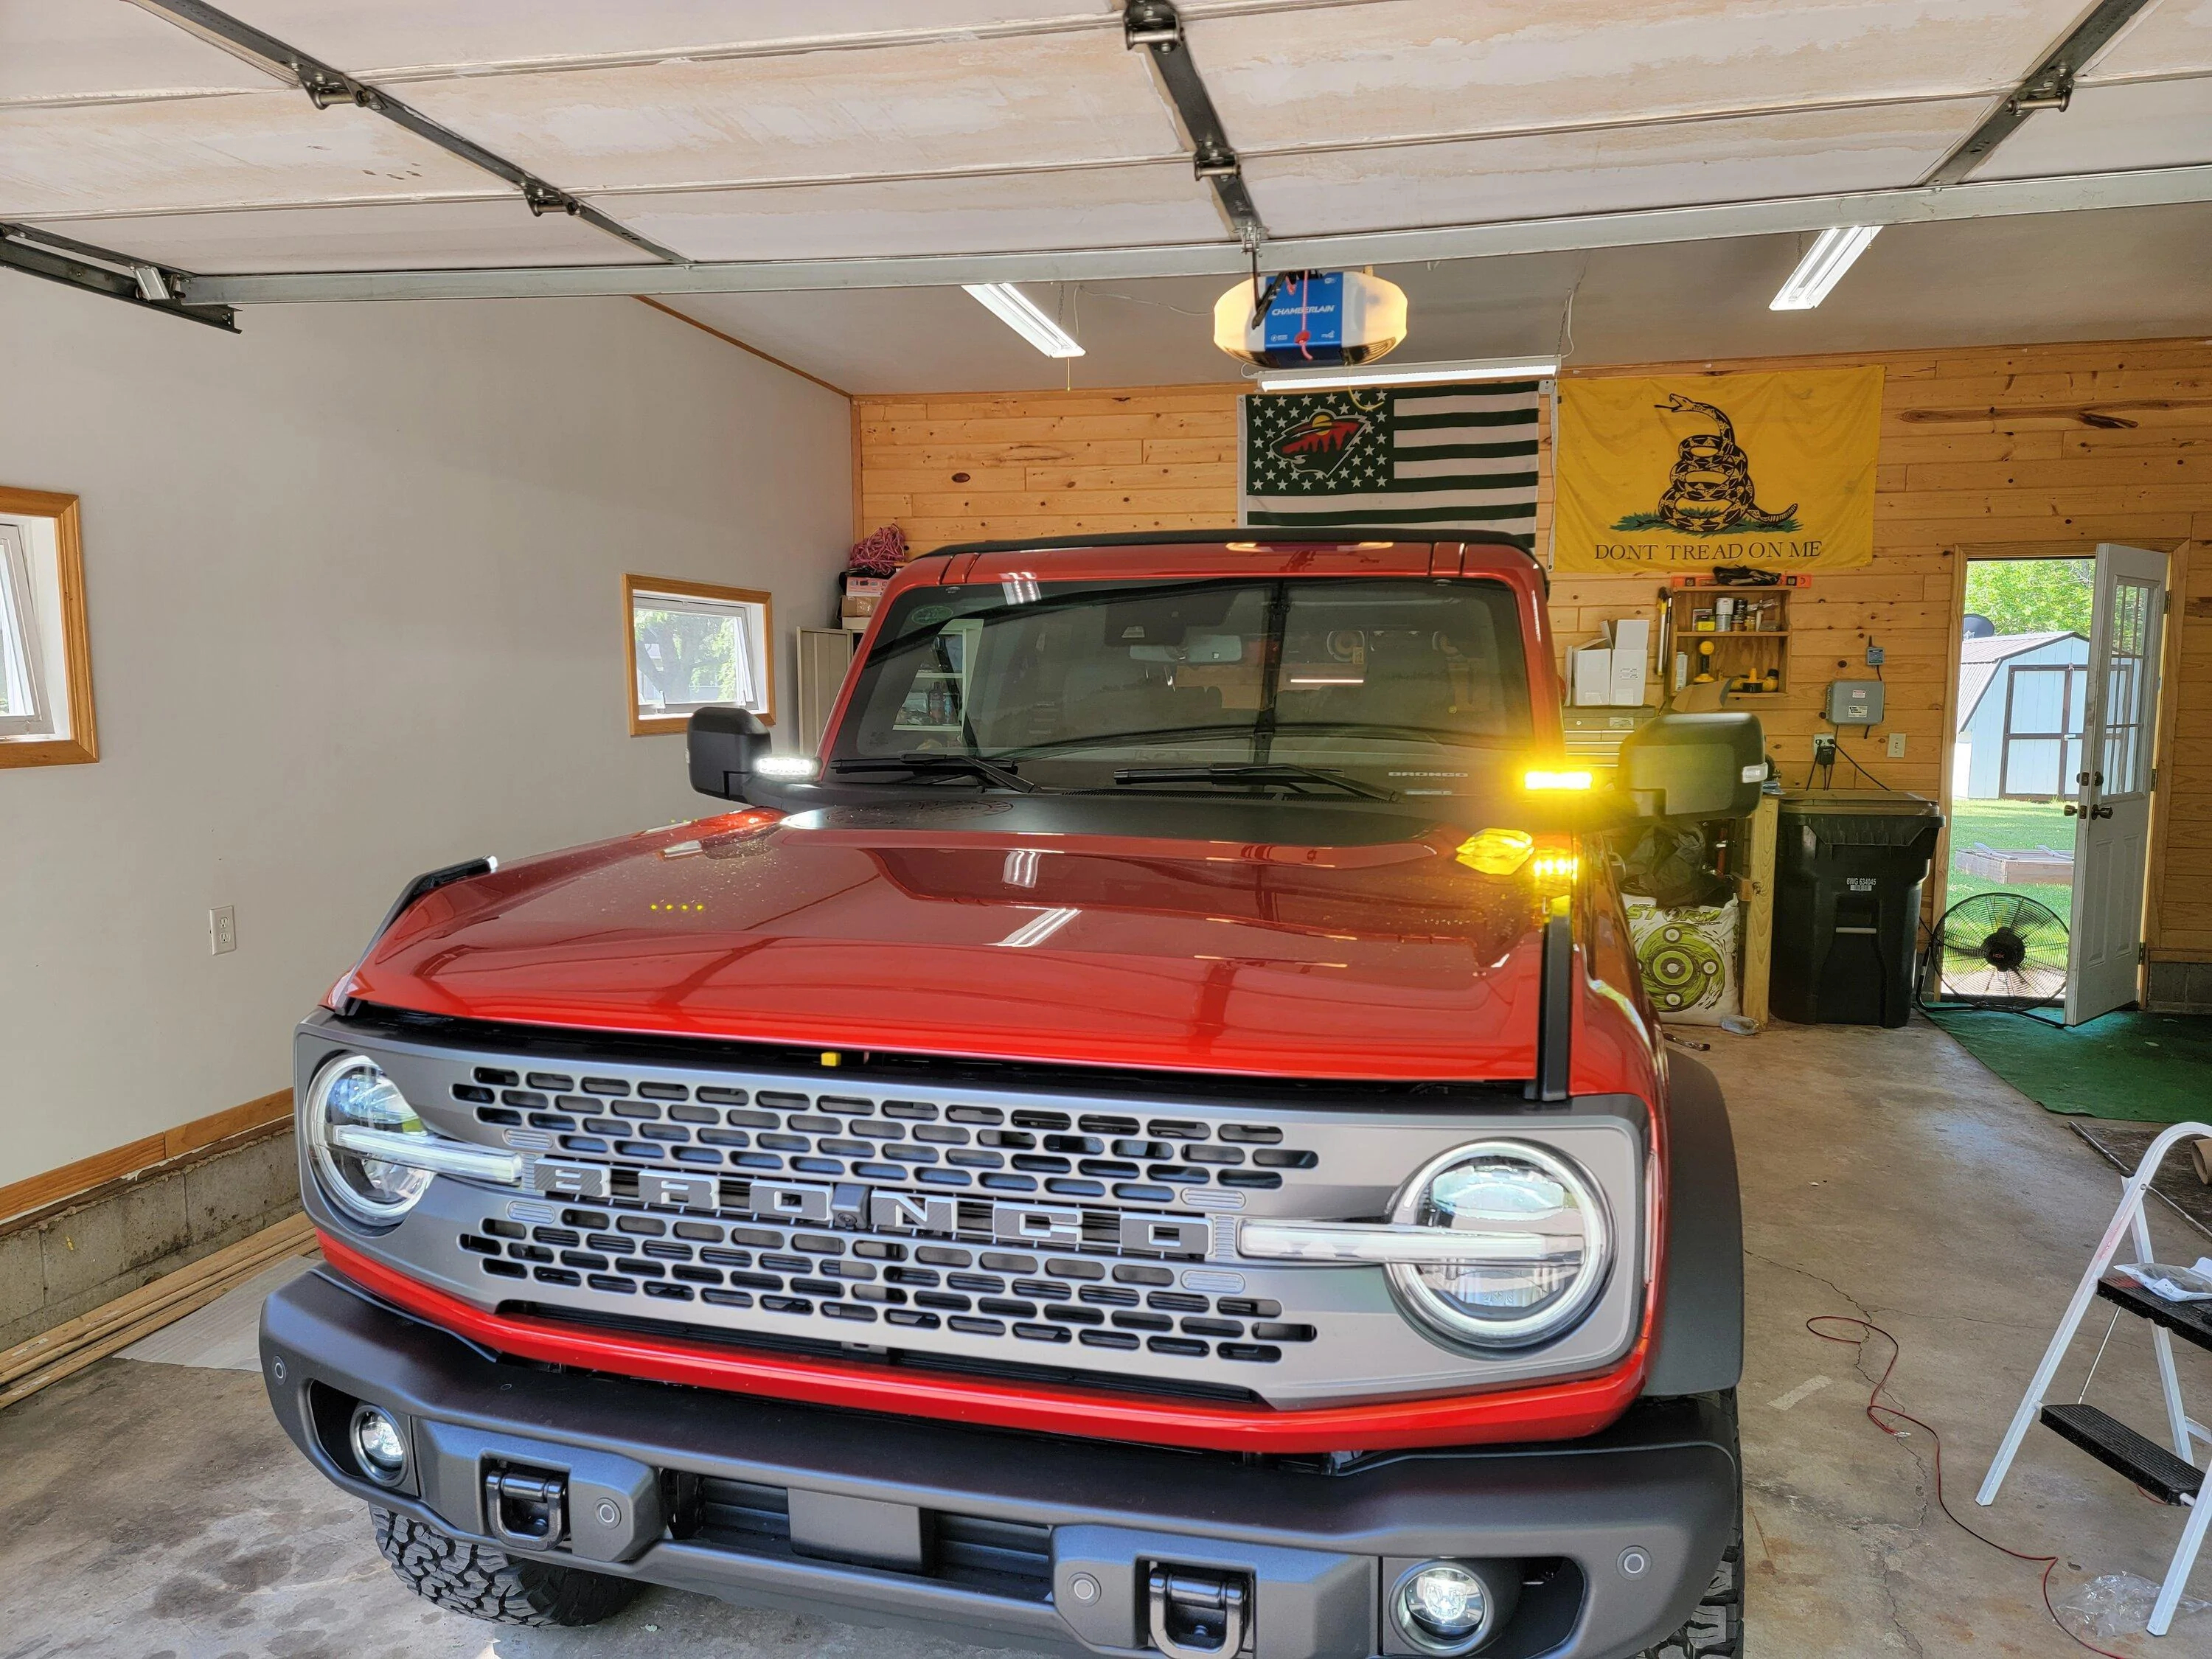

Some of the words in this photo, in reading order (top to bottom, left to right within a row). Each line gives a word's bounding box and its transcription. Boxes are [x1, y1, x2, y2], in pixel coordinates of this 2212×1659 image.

[1272, 305, 1335, 316] CHAMBERLAIN
[1595, 544, 1658, 560] DONT
[1666, 543, 1743, 560] TREAD
[1748, 542, 1782, 558] ON
[1788, 540, 1822, 557] ME
[532, 1156, 1215, 1259] BRONCO
